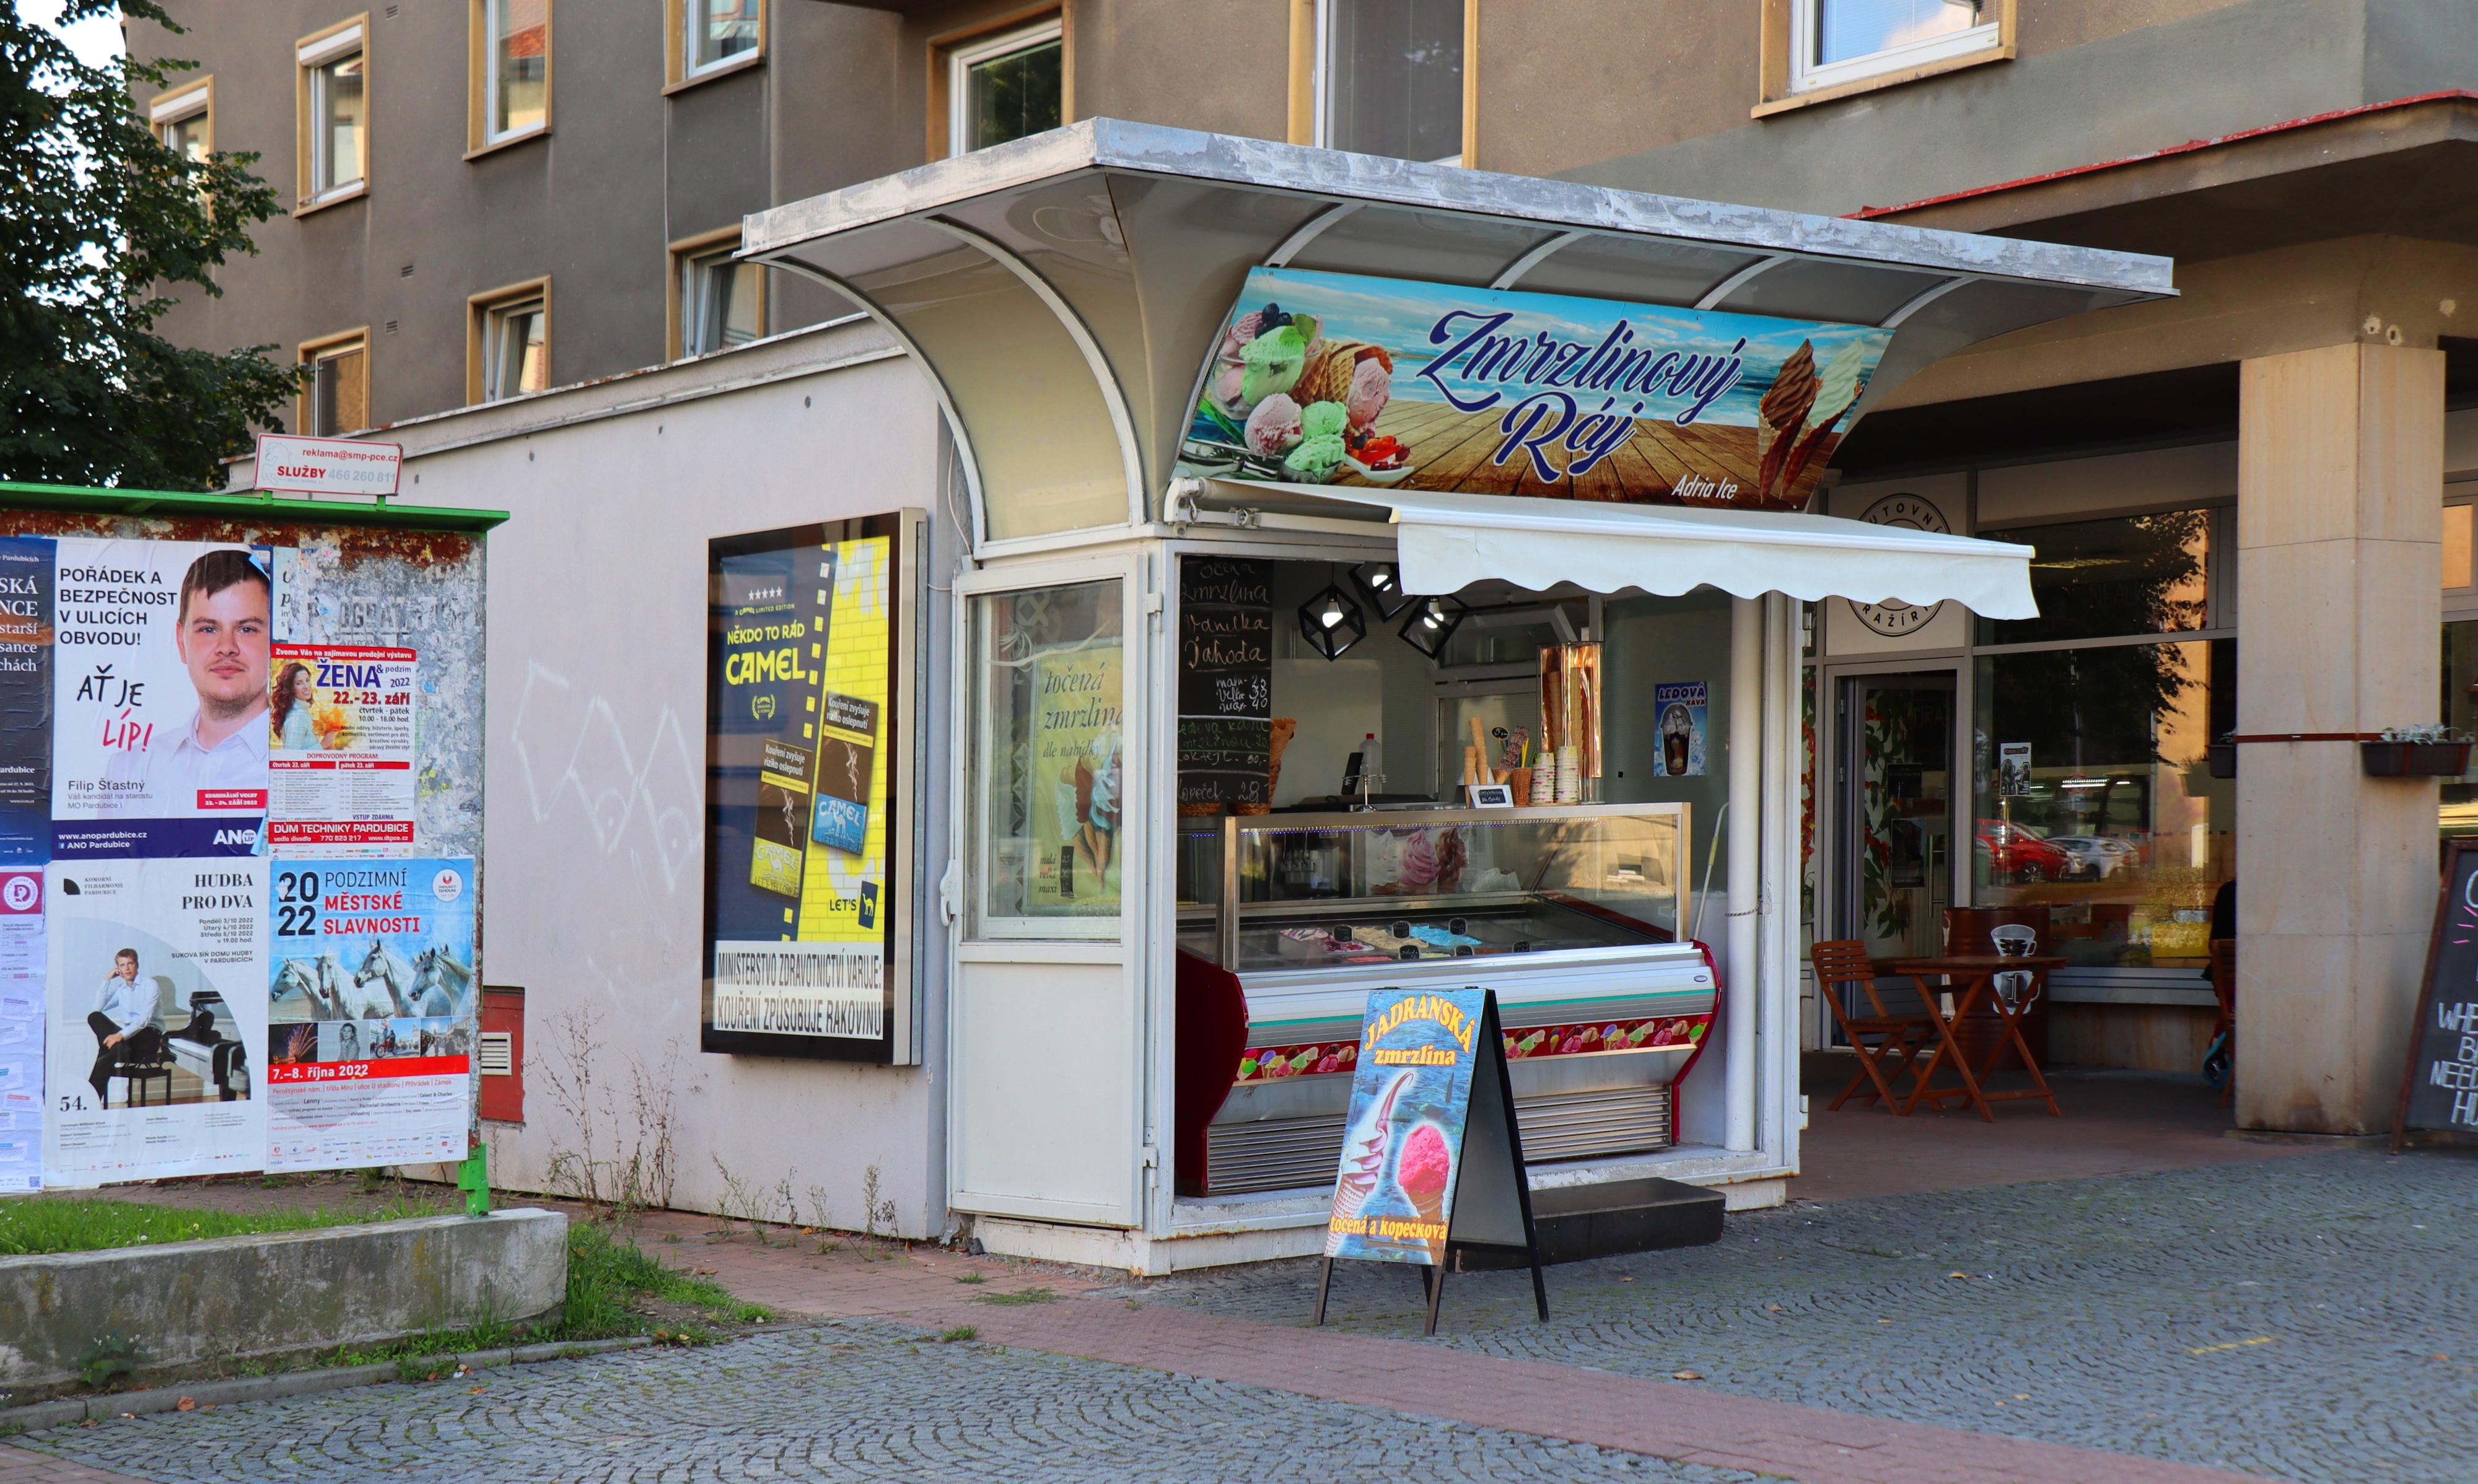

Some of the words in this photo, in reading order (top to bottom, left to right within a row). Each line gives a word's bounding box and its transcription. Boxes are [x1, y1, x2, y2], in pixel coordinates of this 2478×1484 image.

[1416, 309, 1747, 427] Zmrzlinový
[1493, 390, 1645, 484] Ráj
[302, 448, 398, 462] reklama@smp-pce.cz
[277, 466, 326, 478] SLUŽBY
[328, 469, 350, 481] 466
[352, 471, 374, 482] 260
[377, 472, 395, 482] 811
[1672, 474, 1712, 498] Adria
[1715, 476, 1738, 499] Ice
[60, 565, 146, 583] POŘÁDEK
[151, 571, 162, 584] A
[60, 588, 177, 605] BEZPEČNOST
[60, 611, 71, 623] V
[77, 608, 147, 625] ULICÍCH
[60, 631, 141, 645] OBVODU!
[727, 625, 763, 645] NĚKDO
[765, 626, 781, 642] TO
[782, 619, 805, 639] RÁD
[324, 650, 357, 659] zajímavou
[359, 651, 385, 659] prodejní
[1185, 636, 1267, 669] Jahoda
[317, 658, 381, 687] ŽENA
[377, 665, 383, 673] &
[385, 665, 411, 673] podzim
[725, 647, 806, 686] CAMEL
[77, 664, 115, 701] AŤ
[114, 679, 145, 707] JE
[390, 678, 410, 687] 2022
[1045, 661, 1105, 694] točená
[362, 692, 382, 705] 23.
[385, 692, 410, 705] září
[1658, 682, 1705, 702] LEDOVÁ
[828, 697, 849, 711] Kouření
[849, 704, 870, 718] zvyšuje
[1685, 698, 1705, 707] KÁVA
[827, 710, 841, 722] riziko
[843, 715, 869, 729] oslepnutí
[103, 708, 153, 752] LÍP!
[765, 744, 786, 757] Kouření
[786, 751, 805, 765] zvyšuje
[1043, 741, 1057, 757] dle
[1061, 740, 1100, 759] nabídky
[764, 757, 778, 769] riziko
[779, 762, 803, 776] oslepnutí
[68, 780, 94, 791] Filip
[99, 778, 145, 792] Šťastný
[819, 800, 860, 827] CAMEL
[58, 832, 147, 840] www.anopardubice.cz
[274, 823, 298, 833] DŮM
[302, 824, 351, 833] TECHNIKY
[353, 824, 409, 832] PARDUBICE
[89, 840, 130, 849] Pardubice
[757, 845, 796, 870] CAMEL
[1040, 853, 1056, 864] malá
[195, 873, 253, 888] HUDBA
[279, 871, 319, 902] 20
[325, 868, 407, 888] PODZIMNÍ
[1039, 882, 1056, 893] maxi
[182, 896, 216, 910] PRO
[221, 894, 253, 909] DVA
[325, 891, 403, 911] MĚSTSKÉ
[830, 898, 857, 912] LET'S
[278, 906, 316, 936] 22
[323, 917, 420, 935] SLAVNOSTI
[718, 952, 776, 986] MINISTERSTVO
[779, 948, 845, 988] ZDRAVOTNICTVÍ
[847, 954, 882, 989] VARUJE:
[718, 990, 761, 1029] KOUŘENÍ
[763, 992, 823, 1033] ZPŮSOBUJE
[826, 999, 881, 1036] RAKOVINU
[1364, 993, 1476, 1055] JADRANSKÁ
[1375, 1045, 1456, 1066] zmrzlina
[307, 1067, 335, 1080] října
[339, 1065, 369, 1076] 2022
[59, 1095, 88, 1112] 54.
[1329, 1213, 1367, 1233] točená
[1369, 1220, 1377, 1235] a
[1380, 1214, 1448, 1241] kopečková
